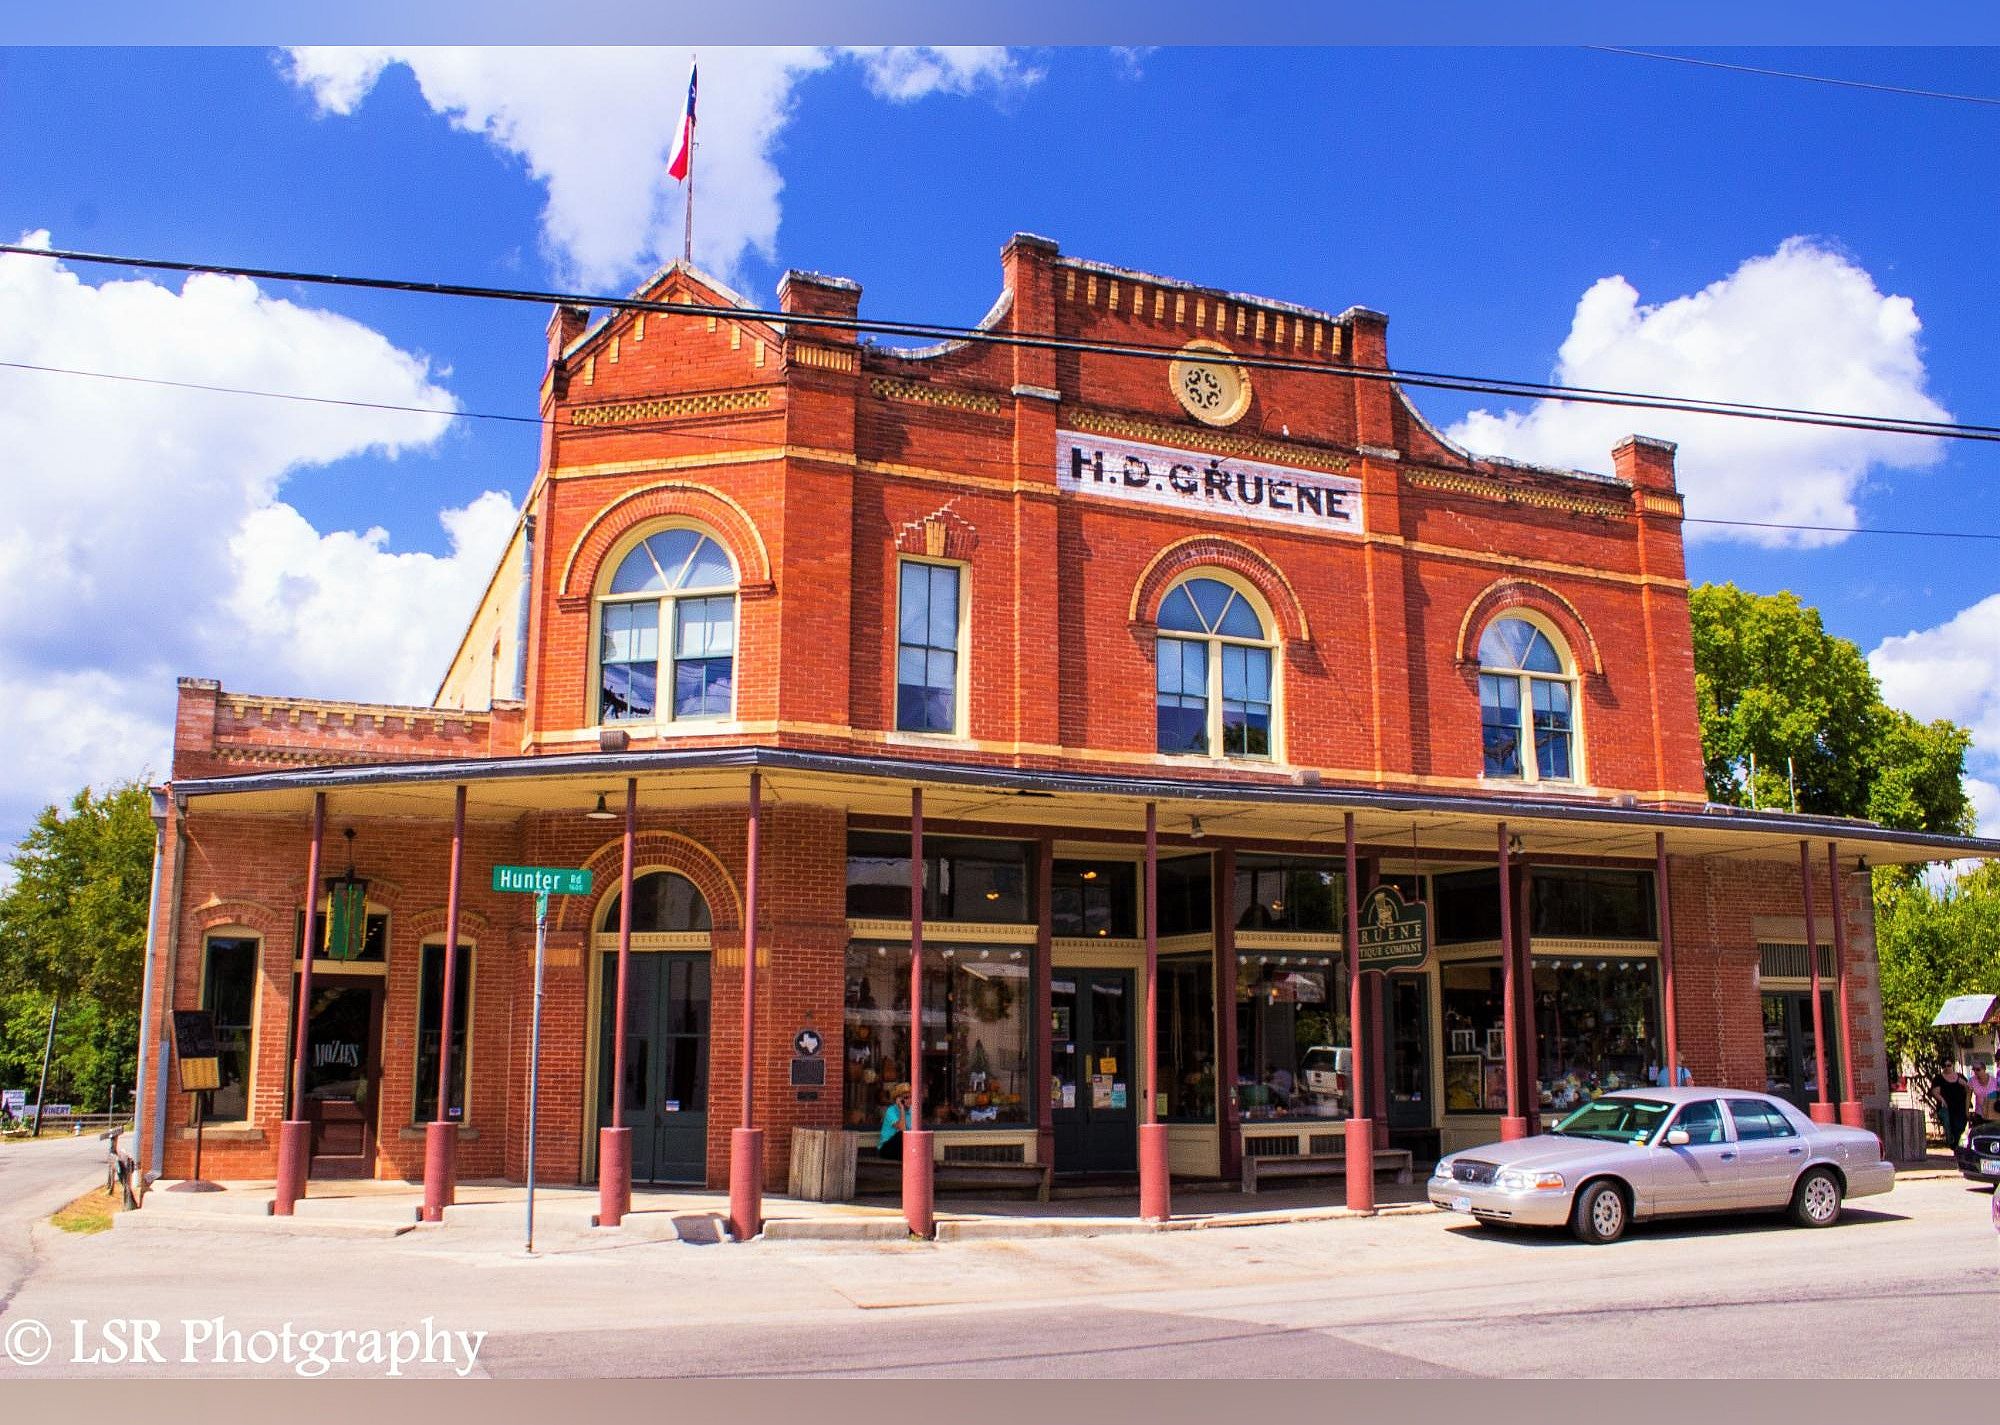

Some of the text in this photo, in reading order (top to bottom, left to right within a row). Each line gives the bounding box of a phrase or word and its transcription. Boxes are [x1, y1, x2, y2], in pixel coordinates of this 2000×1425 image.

[500, 869, 582, 890] Hunter Rd
[1361, 924, 1422, 943] RUENE
[1359, 943, 1422, 958] TIQUE COMPANY
